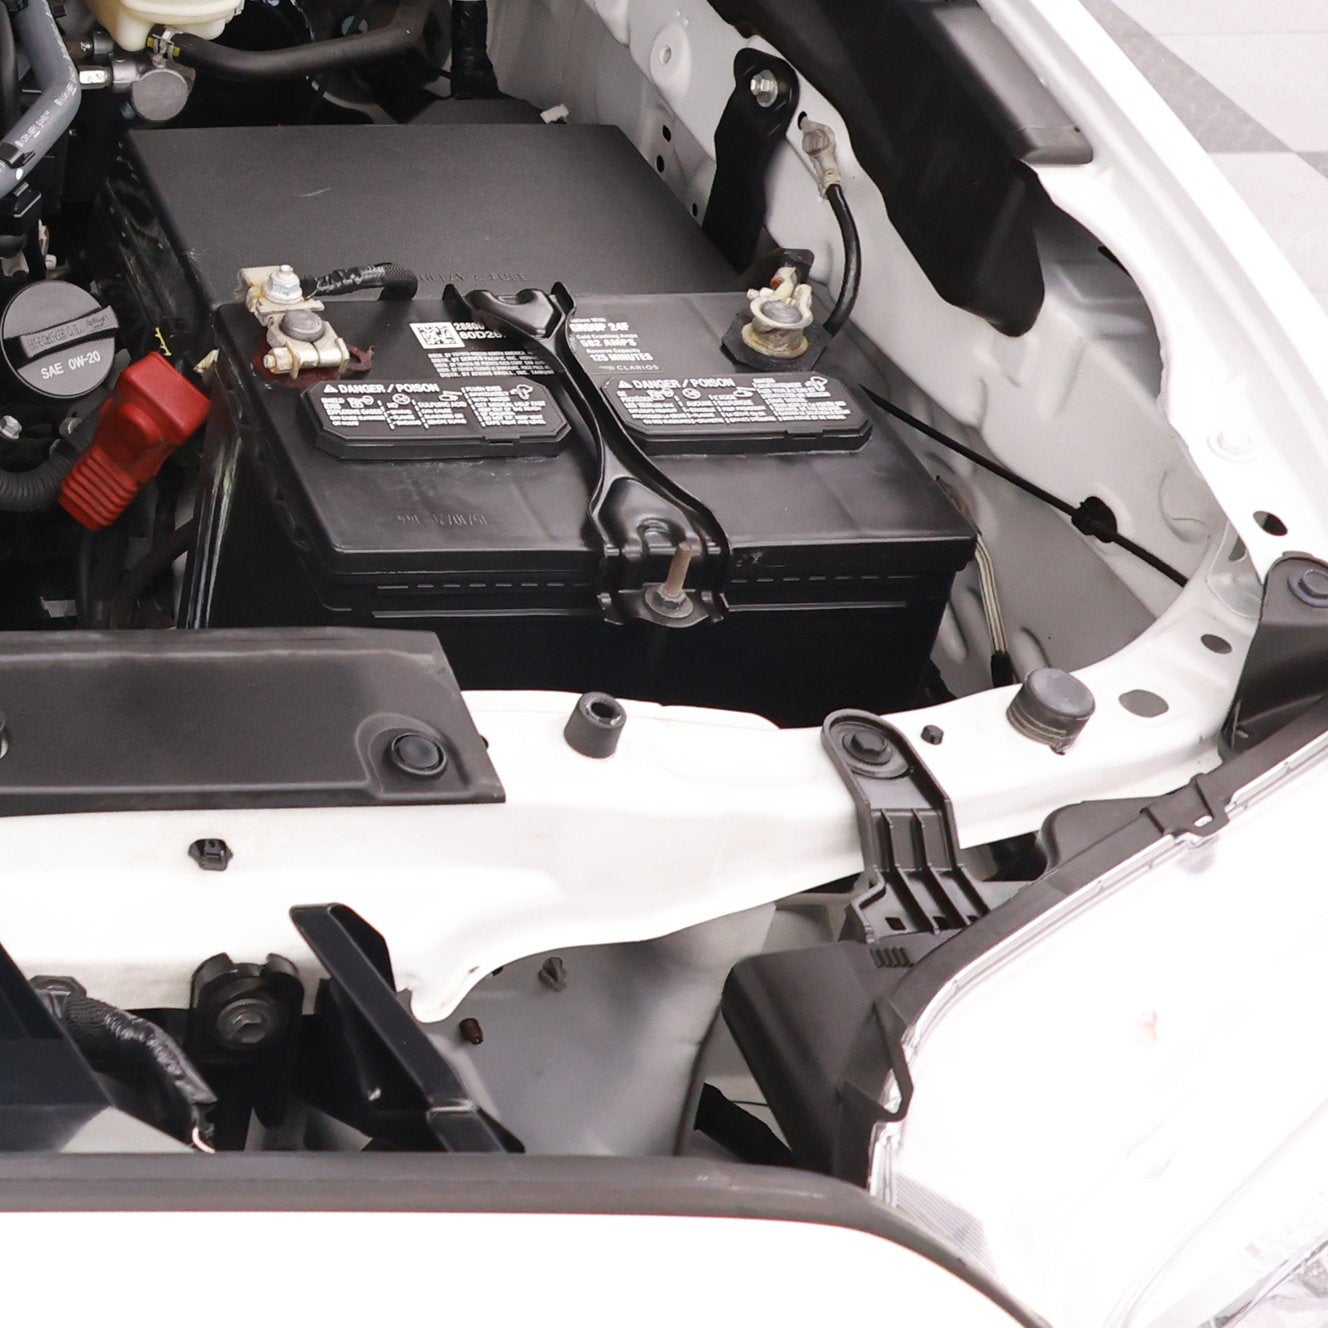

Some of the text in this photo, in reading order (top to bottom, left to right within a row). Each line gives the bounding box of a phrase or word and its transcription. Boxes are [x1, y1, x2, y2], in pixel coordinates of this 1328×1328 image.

[569, 322, 630, 332] GROUP 24F
[603, 338, 638, 347] AMPS
[608, 353, 654, 362] MINUTES
[40, 350, 101, 379] SAE 0W-20
[338, 383, 387, 394] DANGER
[395, 383, 440, 393] POISON
[631, 379, 681, 389] DANGER
[689, 378, 736, 388] POISON
